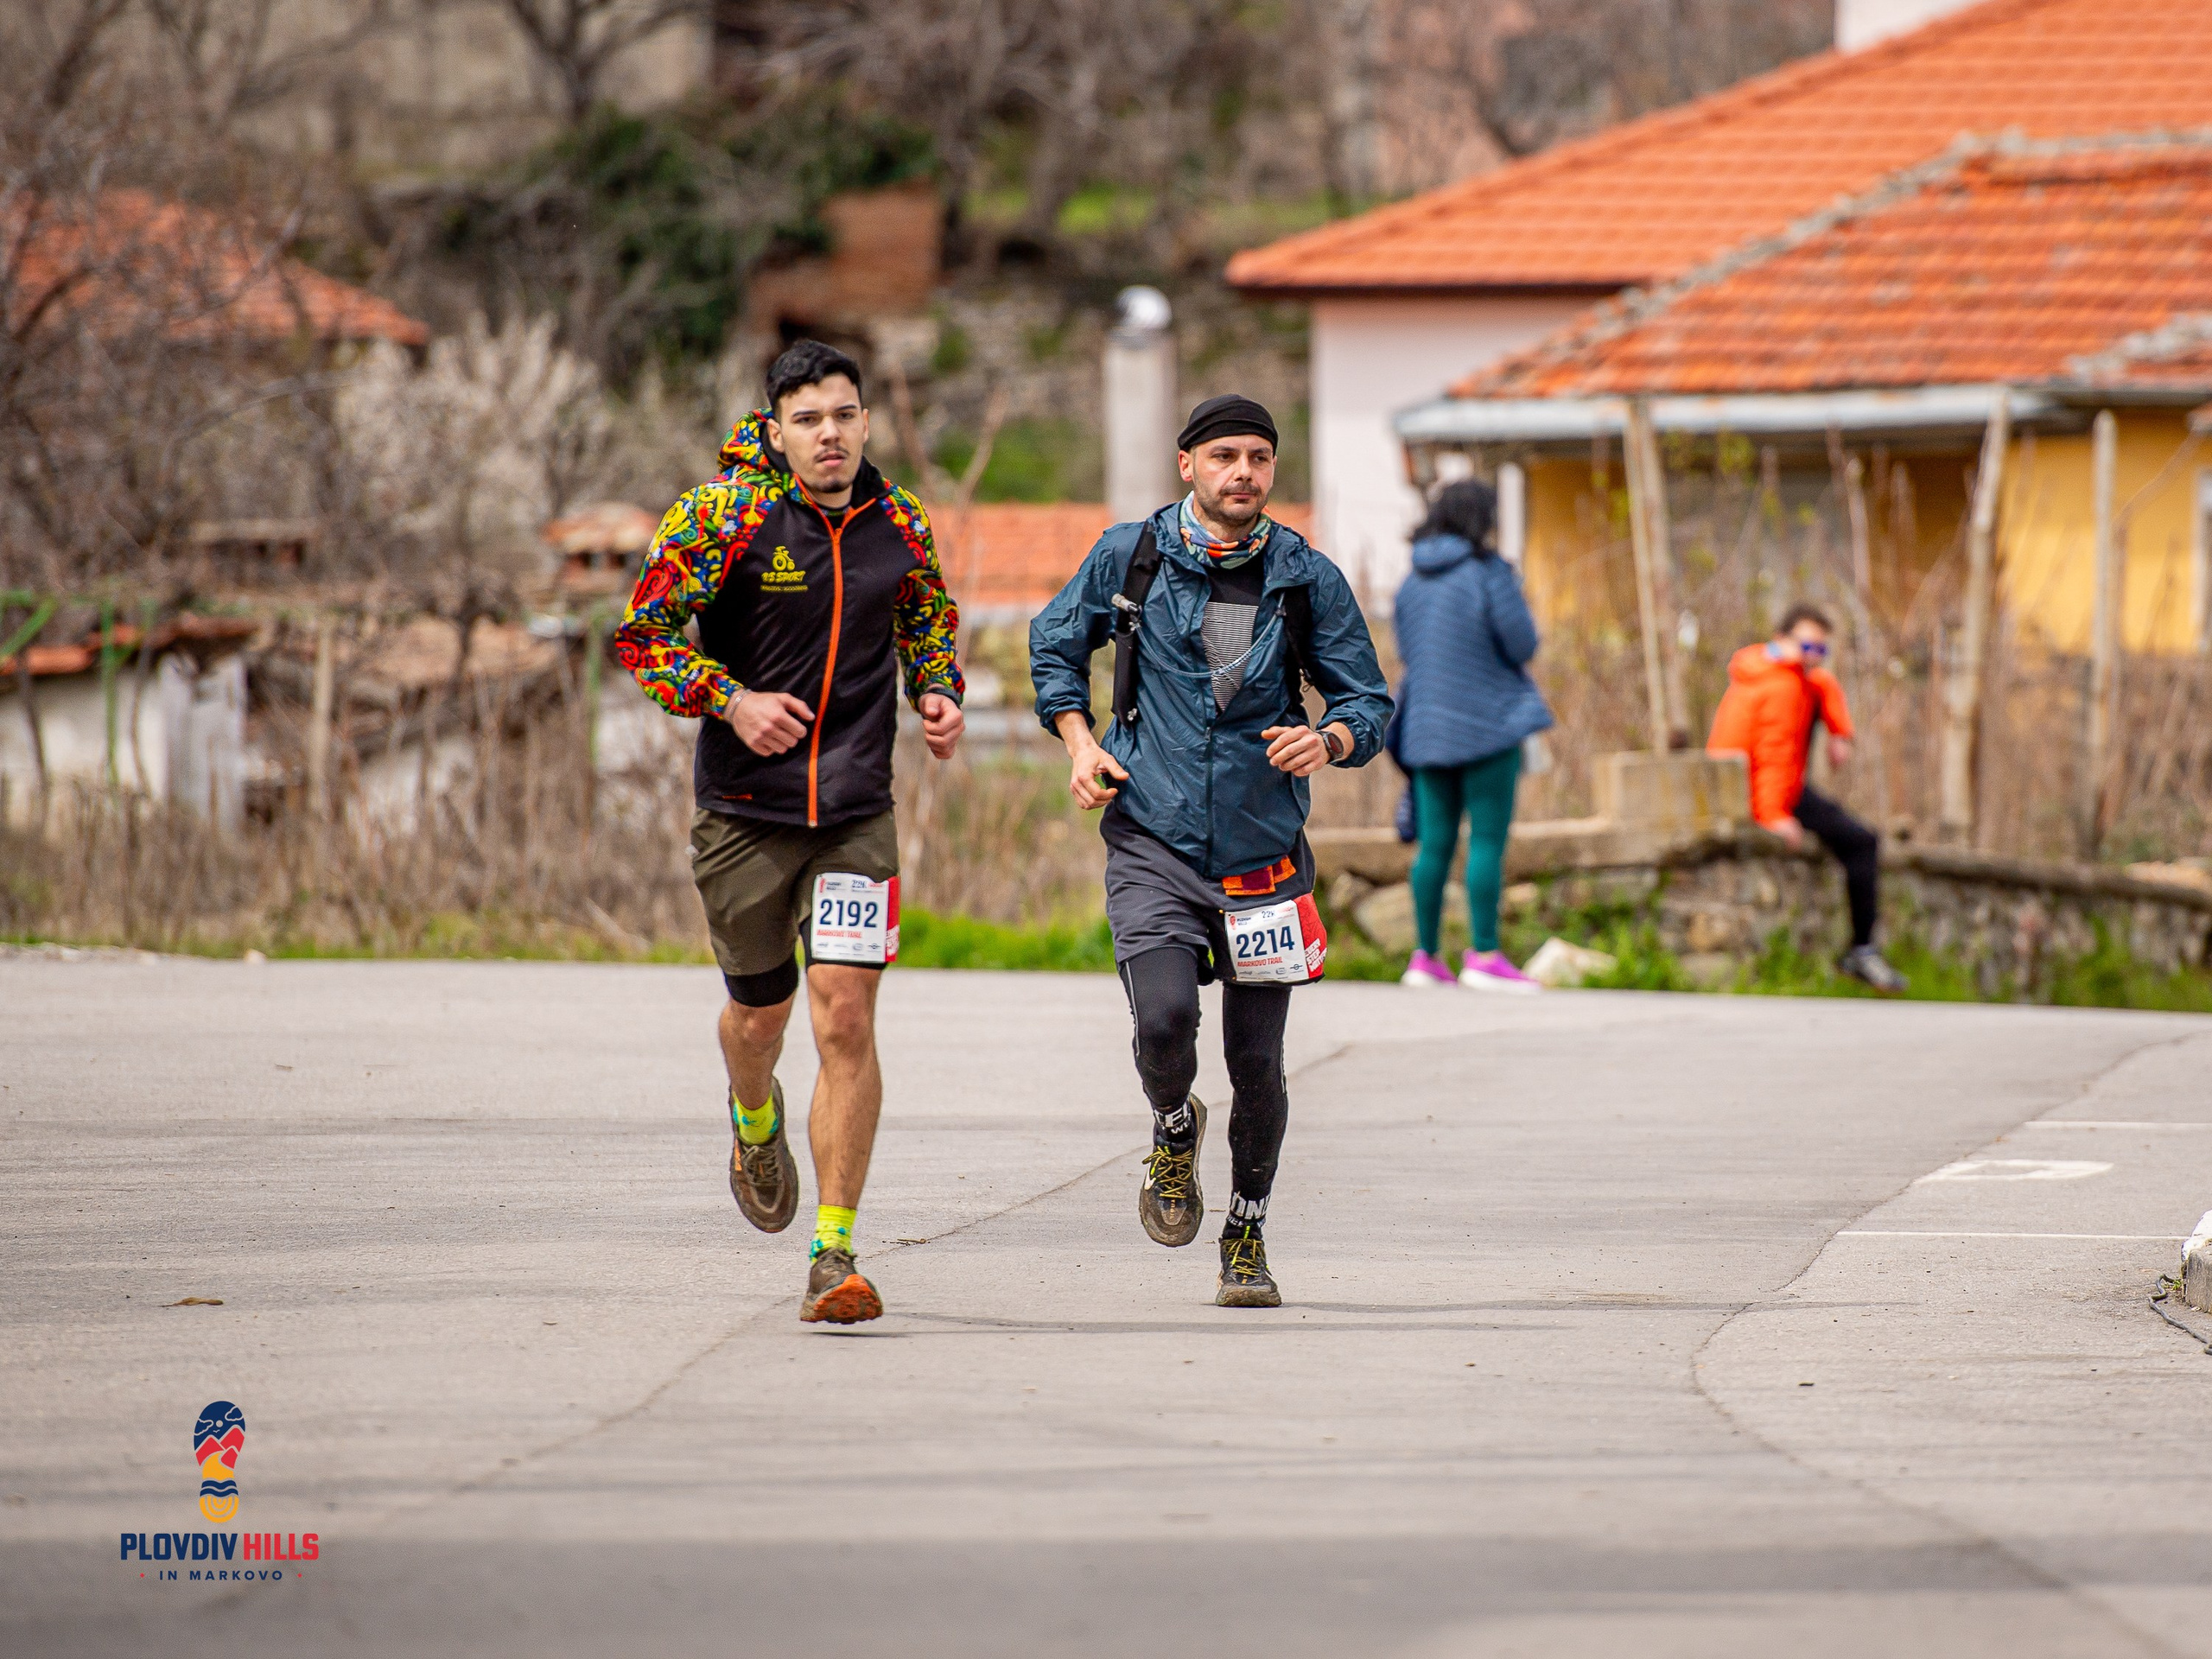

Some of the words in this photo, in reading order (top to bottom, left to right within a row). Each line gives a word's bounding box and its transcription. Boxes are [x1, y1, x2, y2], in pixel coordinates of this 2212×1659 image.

[819, 899, 878, 928] 2192
[1236, 925, 1295, 959] 2214
[1236, 958, 1267, 968] MARKOVO
[1267, 957, 1283, 966] TRAIL
